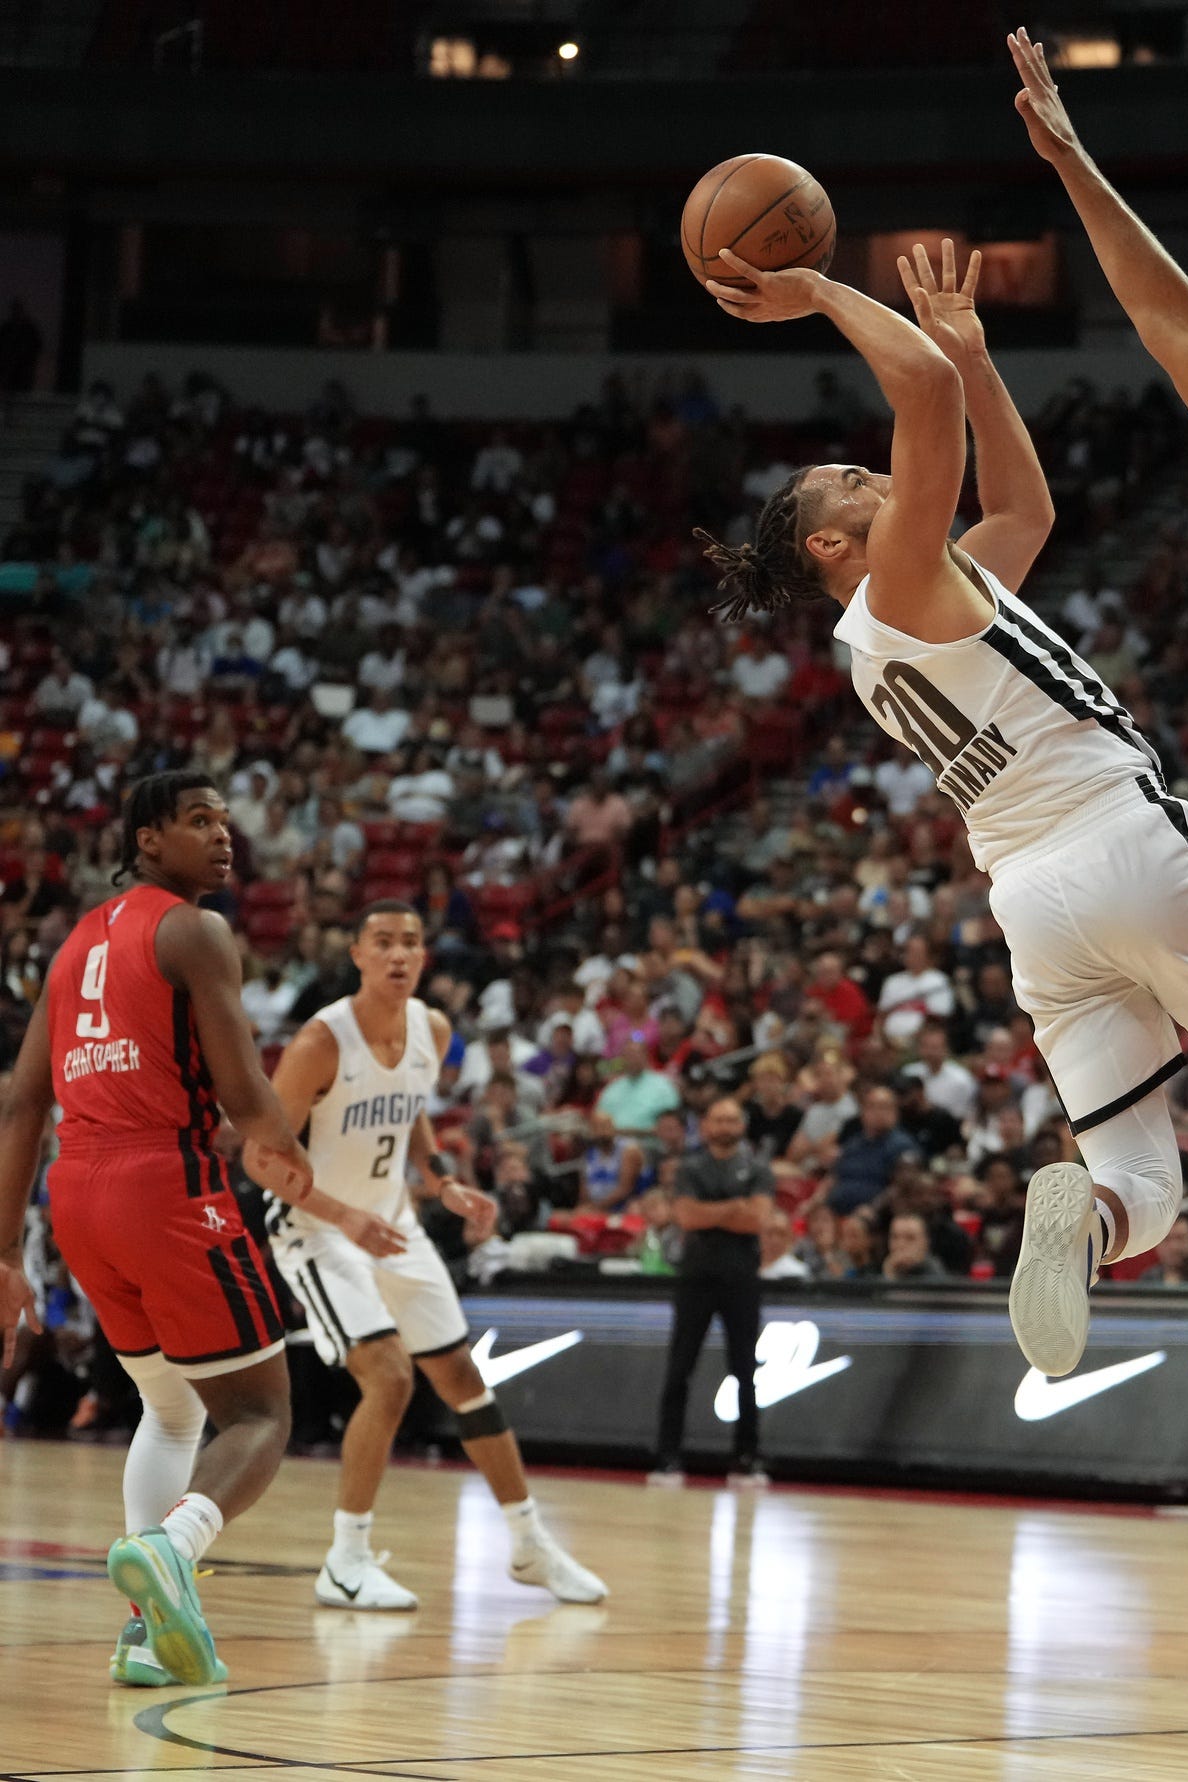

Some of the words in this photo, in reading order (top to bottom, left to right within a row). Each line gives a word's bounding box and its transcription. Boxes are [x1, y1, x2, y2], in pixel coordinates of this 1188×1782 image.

[871, 660, 977, 778] 20
[941, 722, 1018, 817] NNADY
[76, 939, 111, 1039] 9
[370, 1135, 396, 1179] 2
